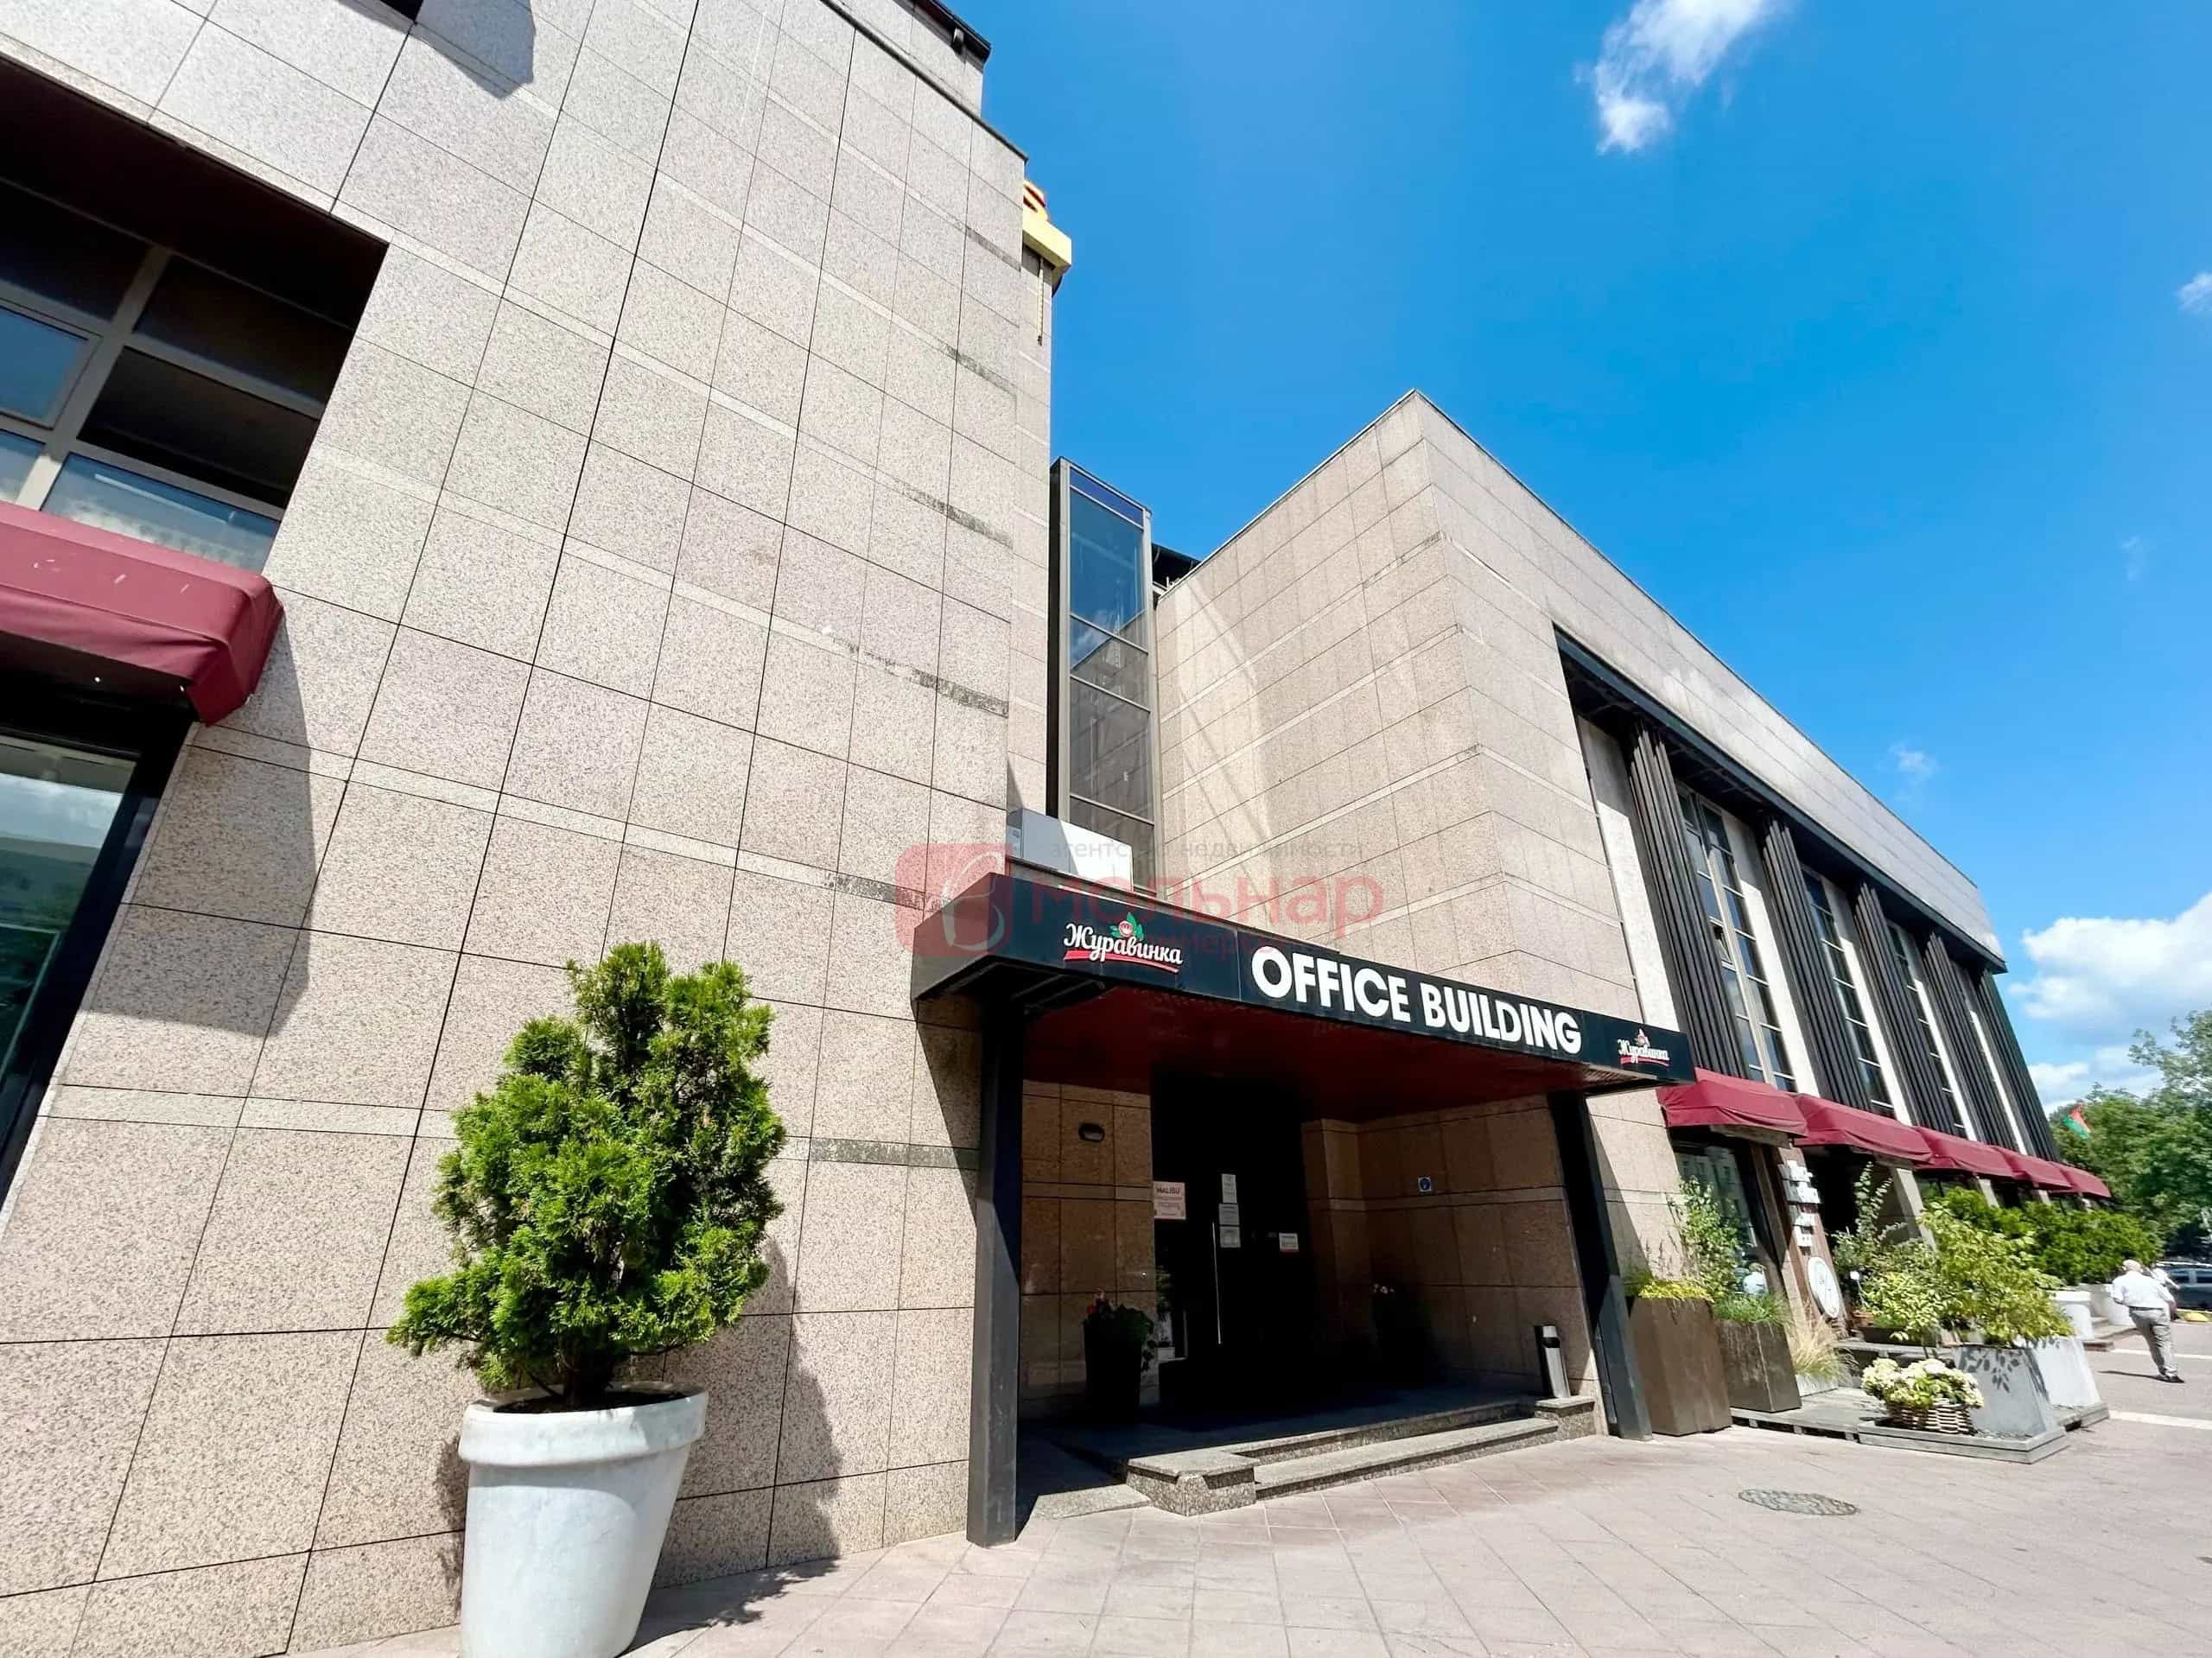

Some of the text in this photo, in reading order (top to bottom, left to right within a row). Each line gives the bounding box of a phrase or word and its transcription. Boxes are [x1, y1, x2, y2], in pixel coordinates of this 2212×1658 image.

[1064, 923, 1183, 964] Журавинка
[1252, 945, 1582, 1054] OFFICE BUILDING
